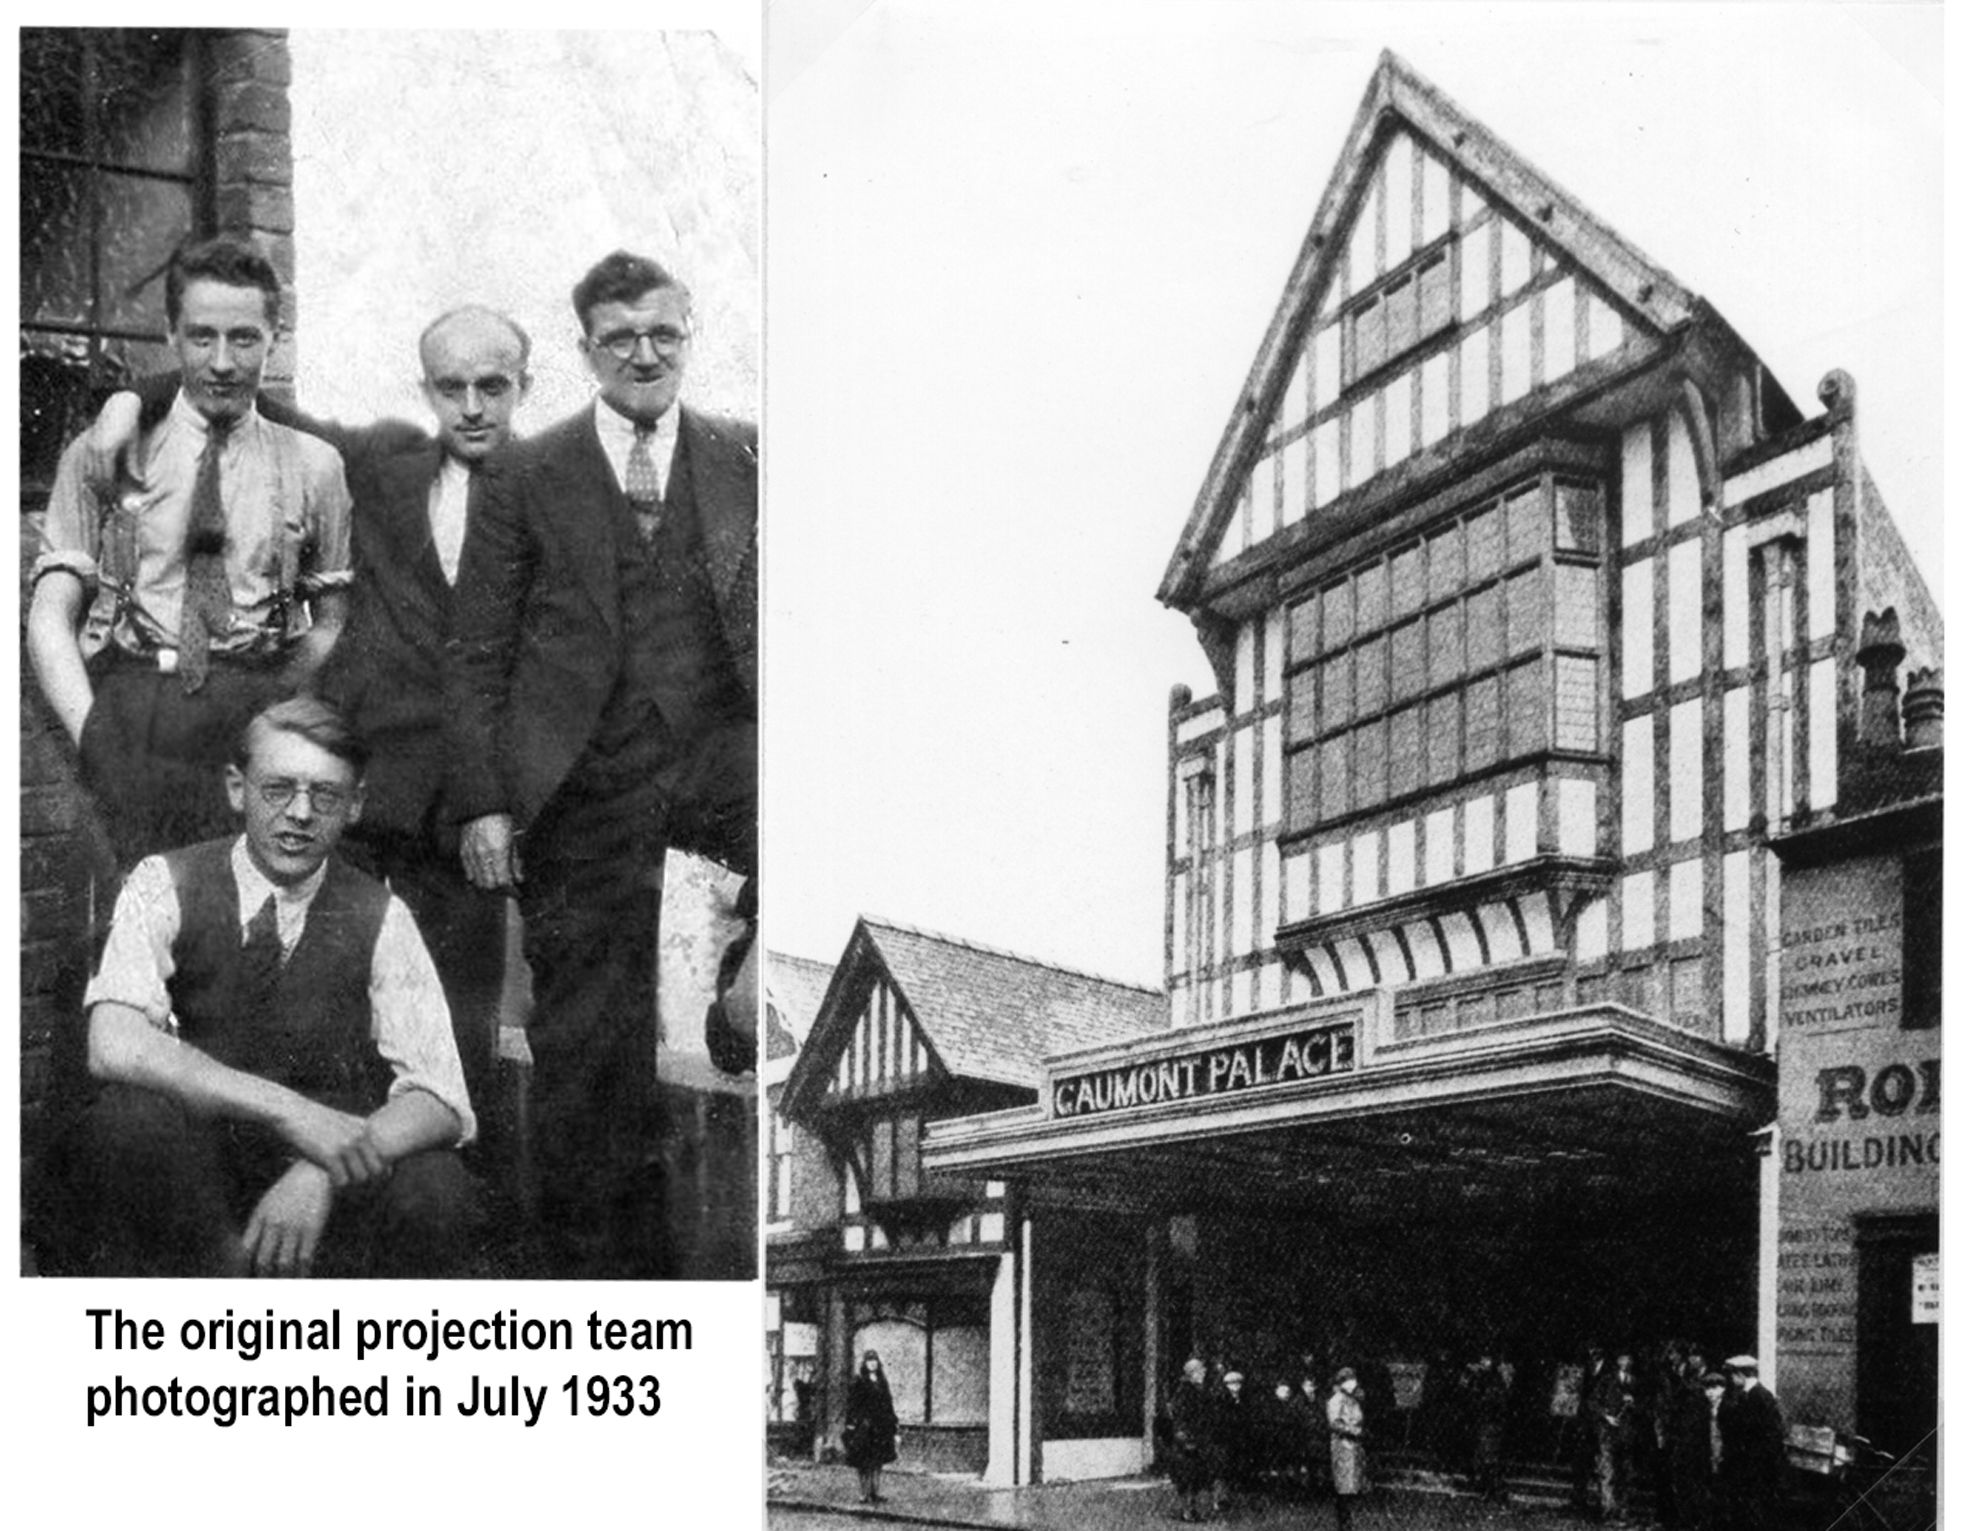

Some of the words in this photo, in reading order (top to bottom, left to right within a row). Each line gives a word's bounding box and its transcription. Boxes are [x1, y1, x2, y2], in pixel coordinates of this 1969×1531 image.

[1853, 913, 1900, 934] TILES
[1794, 946, 1882, 972] GRAVEL
[1781, 998, 1900, 1027] VENTILATORS
[1055, 1058, 1200, 1116] GAUMONT
[1209, 1029, 1354, 1092] PALACE
